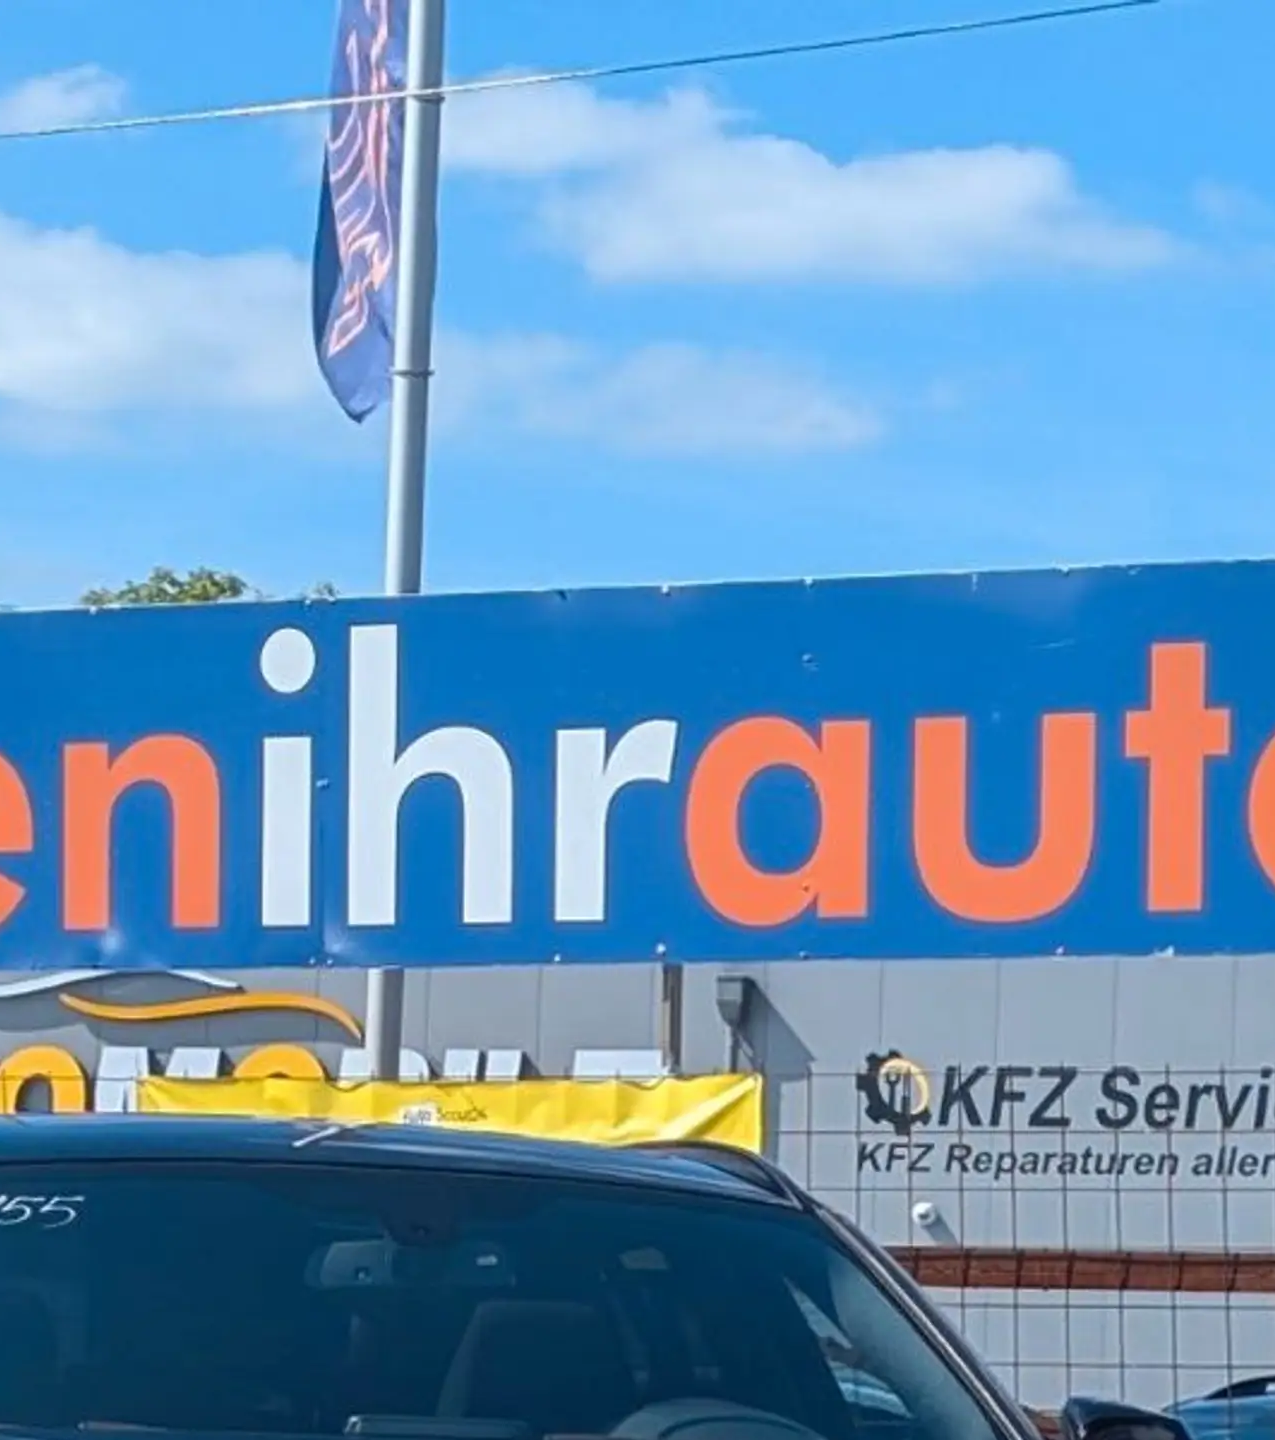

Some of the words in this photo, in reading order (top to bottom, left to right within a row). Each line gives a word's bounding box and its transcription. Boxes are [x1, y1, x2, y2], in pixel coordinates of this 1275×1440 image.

[937, 1064, 1078, 1128] KFZ
[857, 1142, 935, 1173] KFZ
[943, 1142, 1180, 1181] Reparaturen
